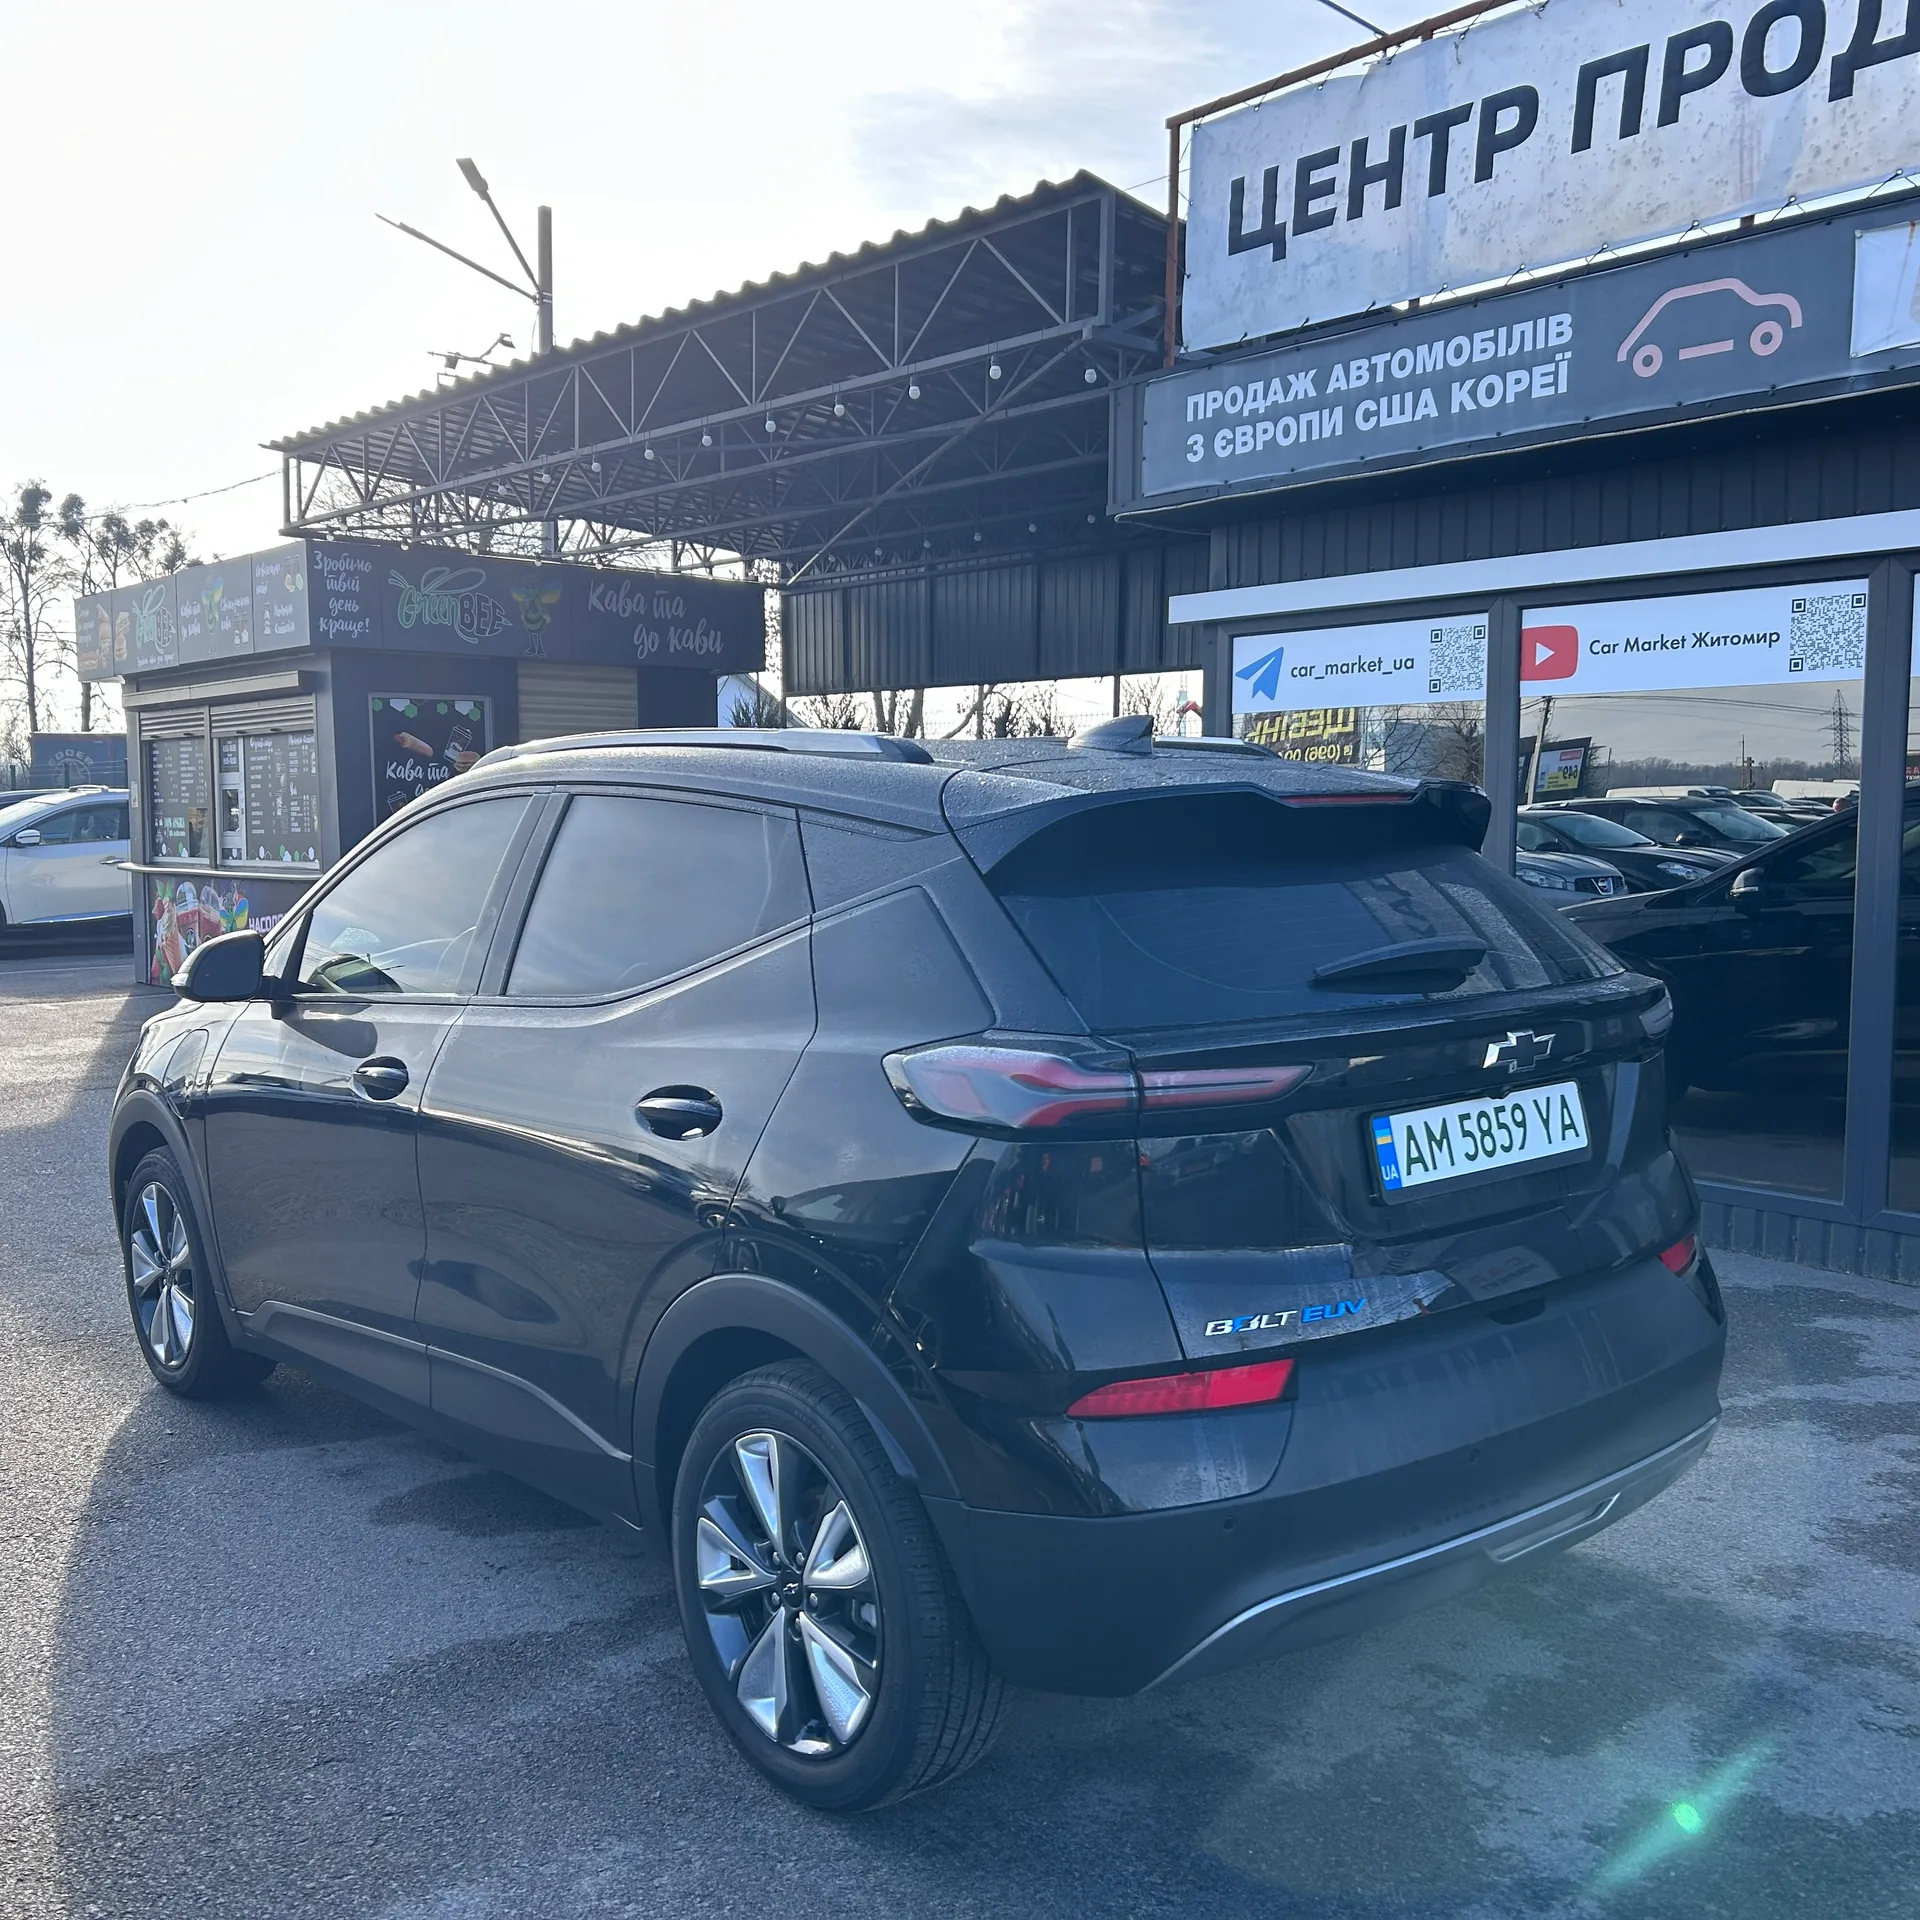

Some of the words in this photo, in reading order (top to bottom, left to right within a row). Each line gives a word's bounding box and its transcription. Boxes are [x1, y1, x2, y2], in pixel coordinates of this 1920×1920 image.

[1228, 85, 1538, 262] ЦЕНТР
[1186, 369, 1316, 422] ПРОДАЖ
[1326, 313, 1573, 394] АВТОМОБІЛІВ
[1186, 434, 1205, 463] З
[1213, 405, 1343, 458] ЄВРОПИ
[1354, 387, 1438, 431] США
[1451, 351, 1572, 414] КОРЕЇ
[314, 550, 373, 577] Зробимо
[326, 572, 360, 592] твій
[329, 596, 360, 616] день
[588, 579, 648, 618] Кава
[652, 590, 686, 620] та
[319, 616, 370, 639] краще!
[633, 623, 660, 660] до
[667, 617, 724, 655] кави
[1589, 639, 1619, 655] Car
[1624, 633, 1687, 653] Market
[1691, 631, 1780, 648] Житомир
[1291, 655, 1415, 680] car_market_ua
[386, 758, 425, 781] Кава
[427, 762, 450, 780] та
[1381, 1165, 1399, 1182] UA
[1405, 1116, 1455, 1177] AM
[1458, 1102, 1527, 1161] 5859
[1533, 1094, 1580, 1144] YA
[1205, 1310, 1298, 1336] BOLT
[1301, 1297, 1367, 1323] EUV
